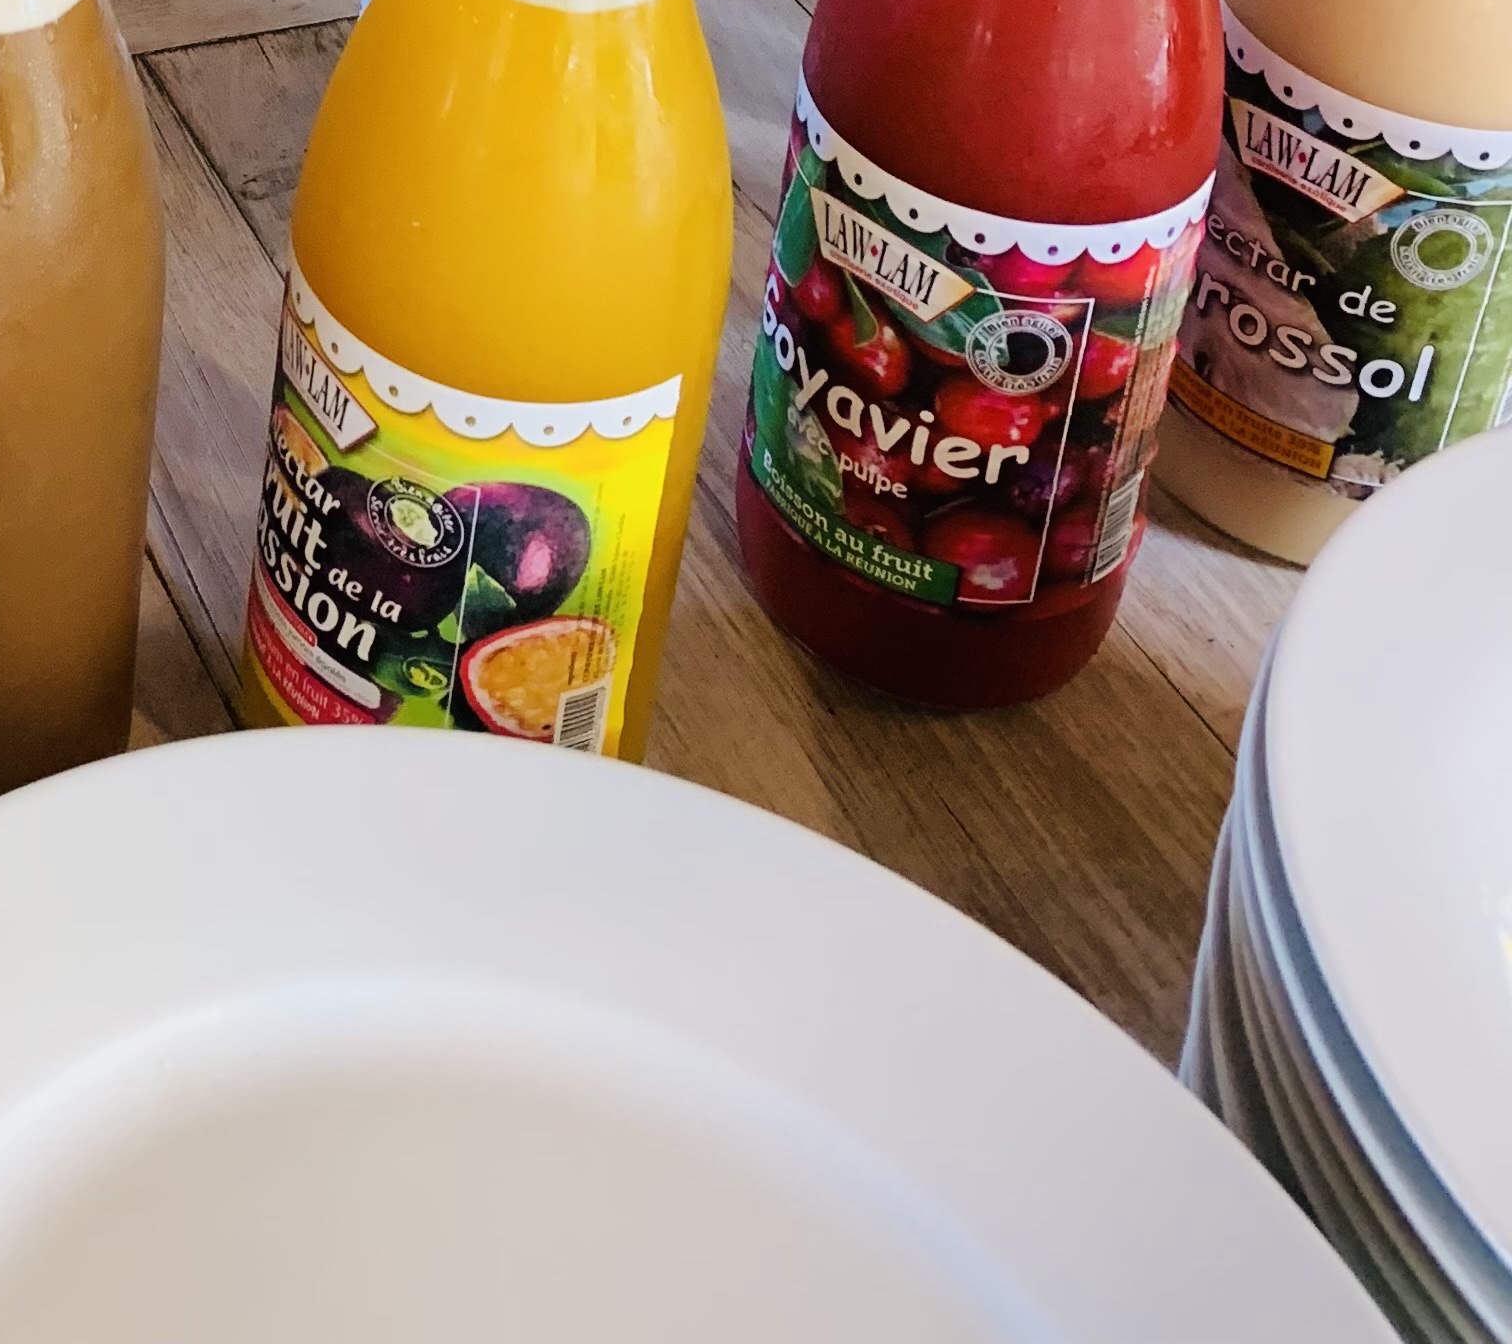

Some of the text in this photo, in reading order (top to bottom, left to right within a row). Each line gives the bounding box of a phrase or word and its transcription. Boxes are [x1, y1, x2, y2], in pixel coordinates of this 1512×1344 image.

[1246, 111, 1302, 170] LAW
[1300, 146, 1372, 207] LAM
[824, 202, 873, 265] LAW
[875, 238, 940, 306] LAM
[1207, 215, 1398, 324] ectar de
[762, 272, 1030, 485] Goyavier
[1197, 269, 1435, 403] rossol
[307, 357, 352, 432] LAM
[763, 447, 935, 582] Boisson au fruit
[838, 452, 909, 500] pulpe
[328, 566, 363, 602] de
[370, 589, 403, 624] la
[825, 541, 843, 558] LA
